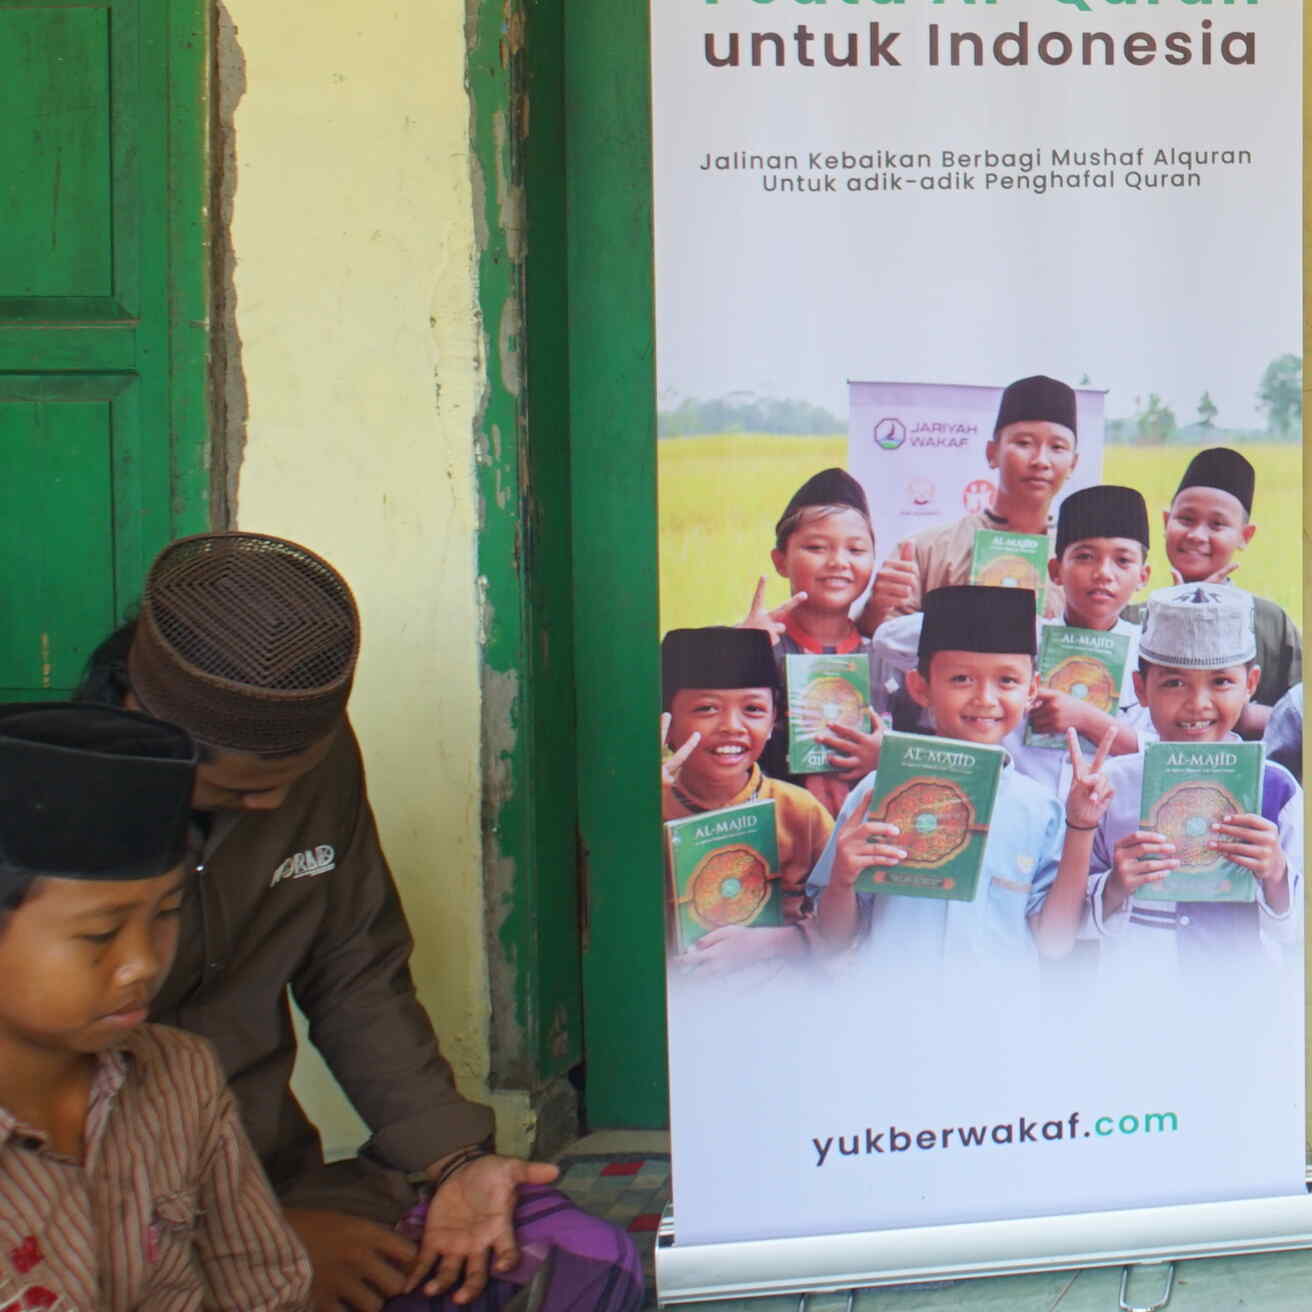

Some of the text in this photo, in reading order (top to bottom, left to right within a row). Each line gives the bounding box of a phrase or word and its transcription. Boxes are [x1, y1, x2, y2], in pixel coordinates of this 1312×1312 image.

[704, 18, 1257, 68] untuk Indonesia
[699, 146, 1252, 172] Jalinan Kebaikan Berbagi Mushaf Alquran
[762, 168, 1201, 193] Untuk adik-adik Penghafal Quran
[911, 422, 978, 434] JARIYAH
[911, 438, 968, 448] WAKAF
[812, 1108, 1180, 1166] yukberwakaf.com
